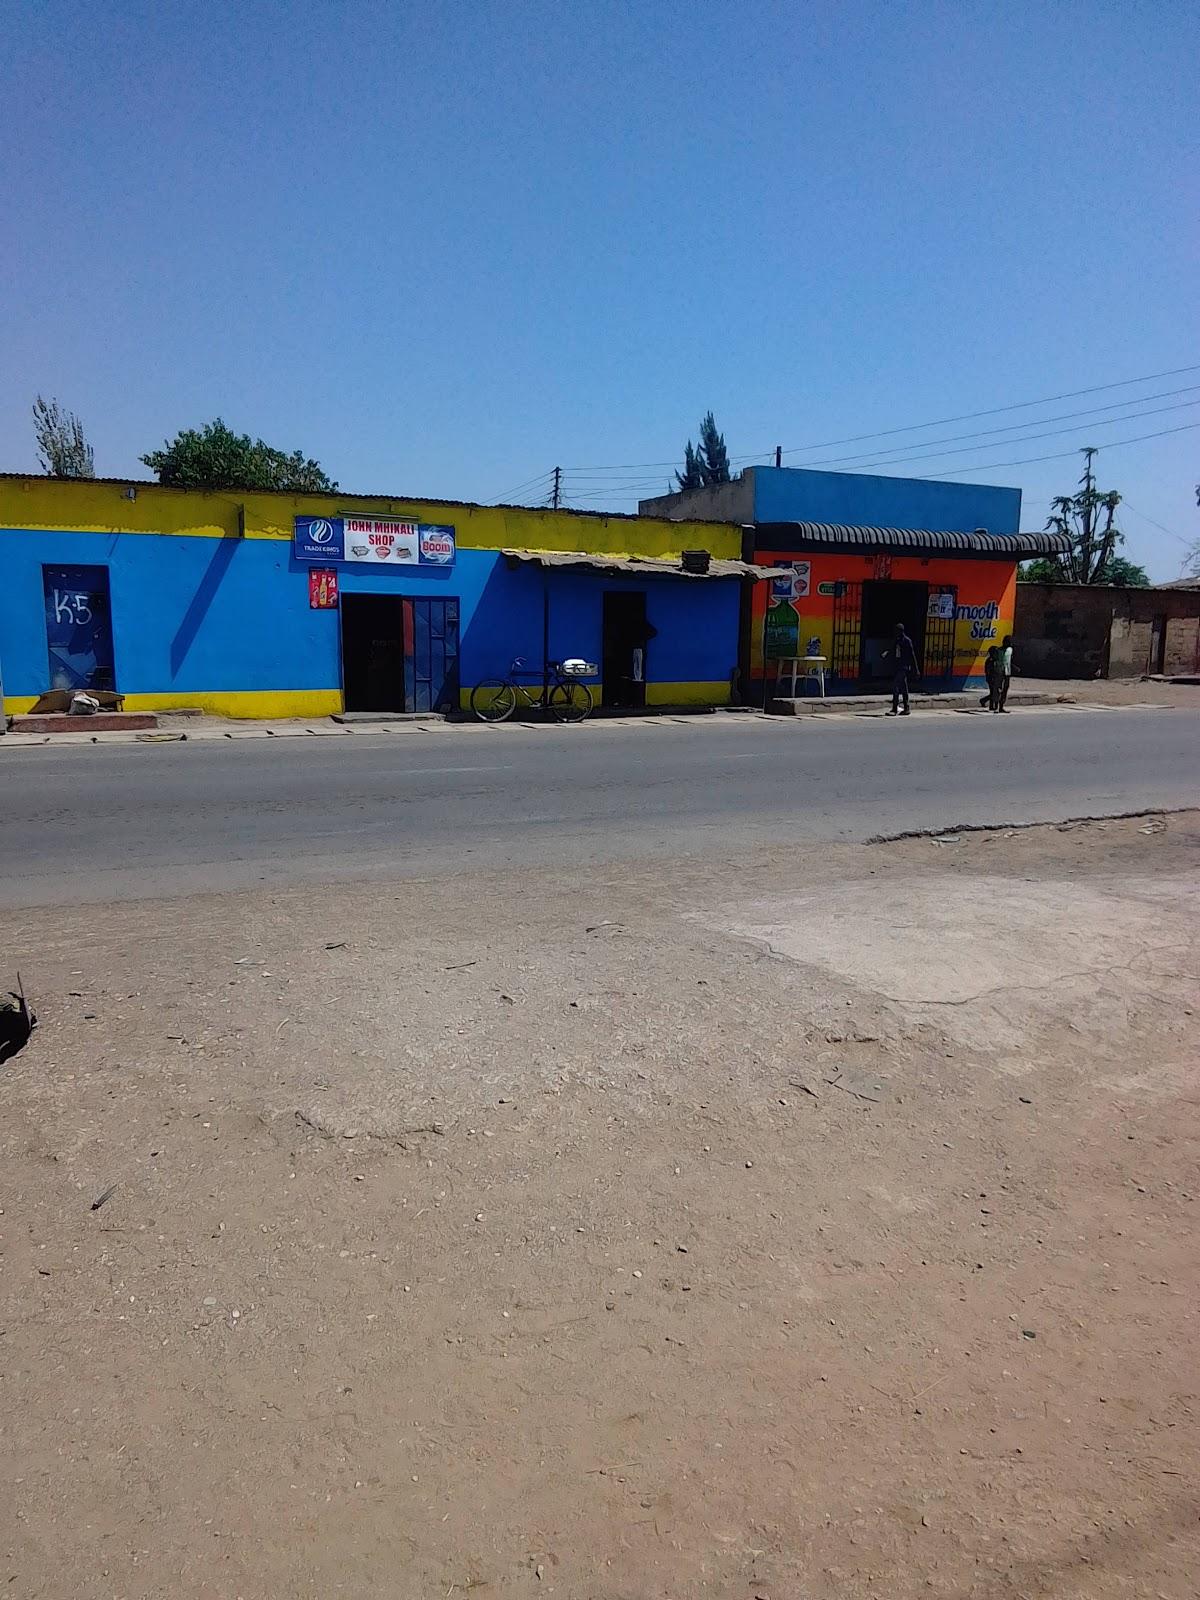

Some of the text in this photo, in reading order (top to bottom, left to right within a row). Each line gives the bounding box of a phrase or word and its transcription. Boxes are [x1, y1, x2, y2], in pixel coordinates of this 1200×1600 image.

[347, 520, 372, 532] JOHN
[368, 534, 395, 546] SHOP
[970, 621, 997, 639] Side
